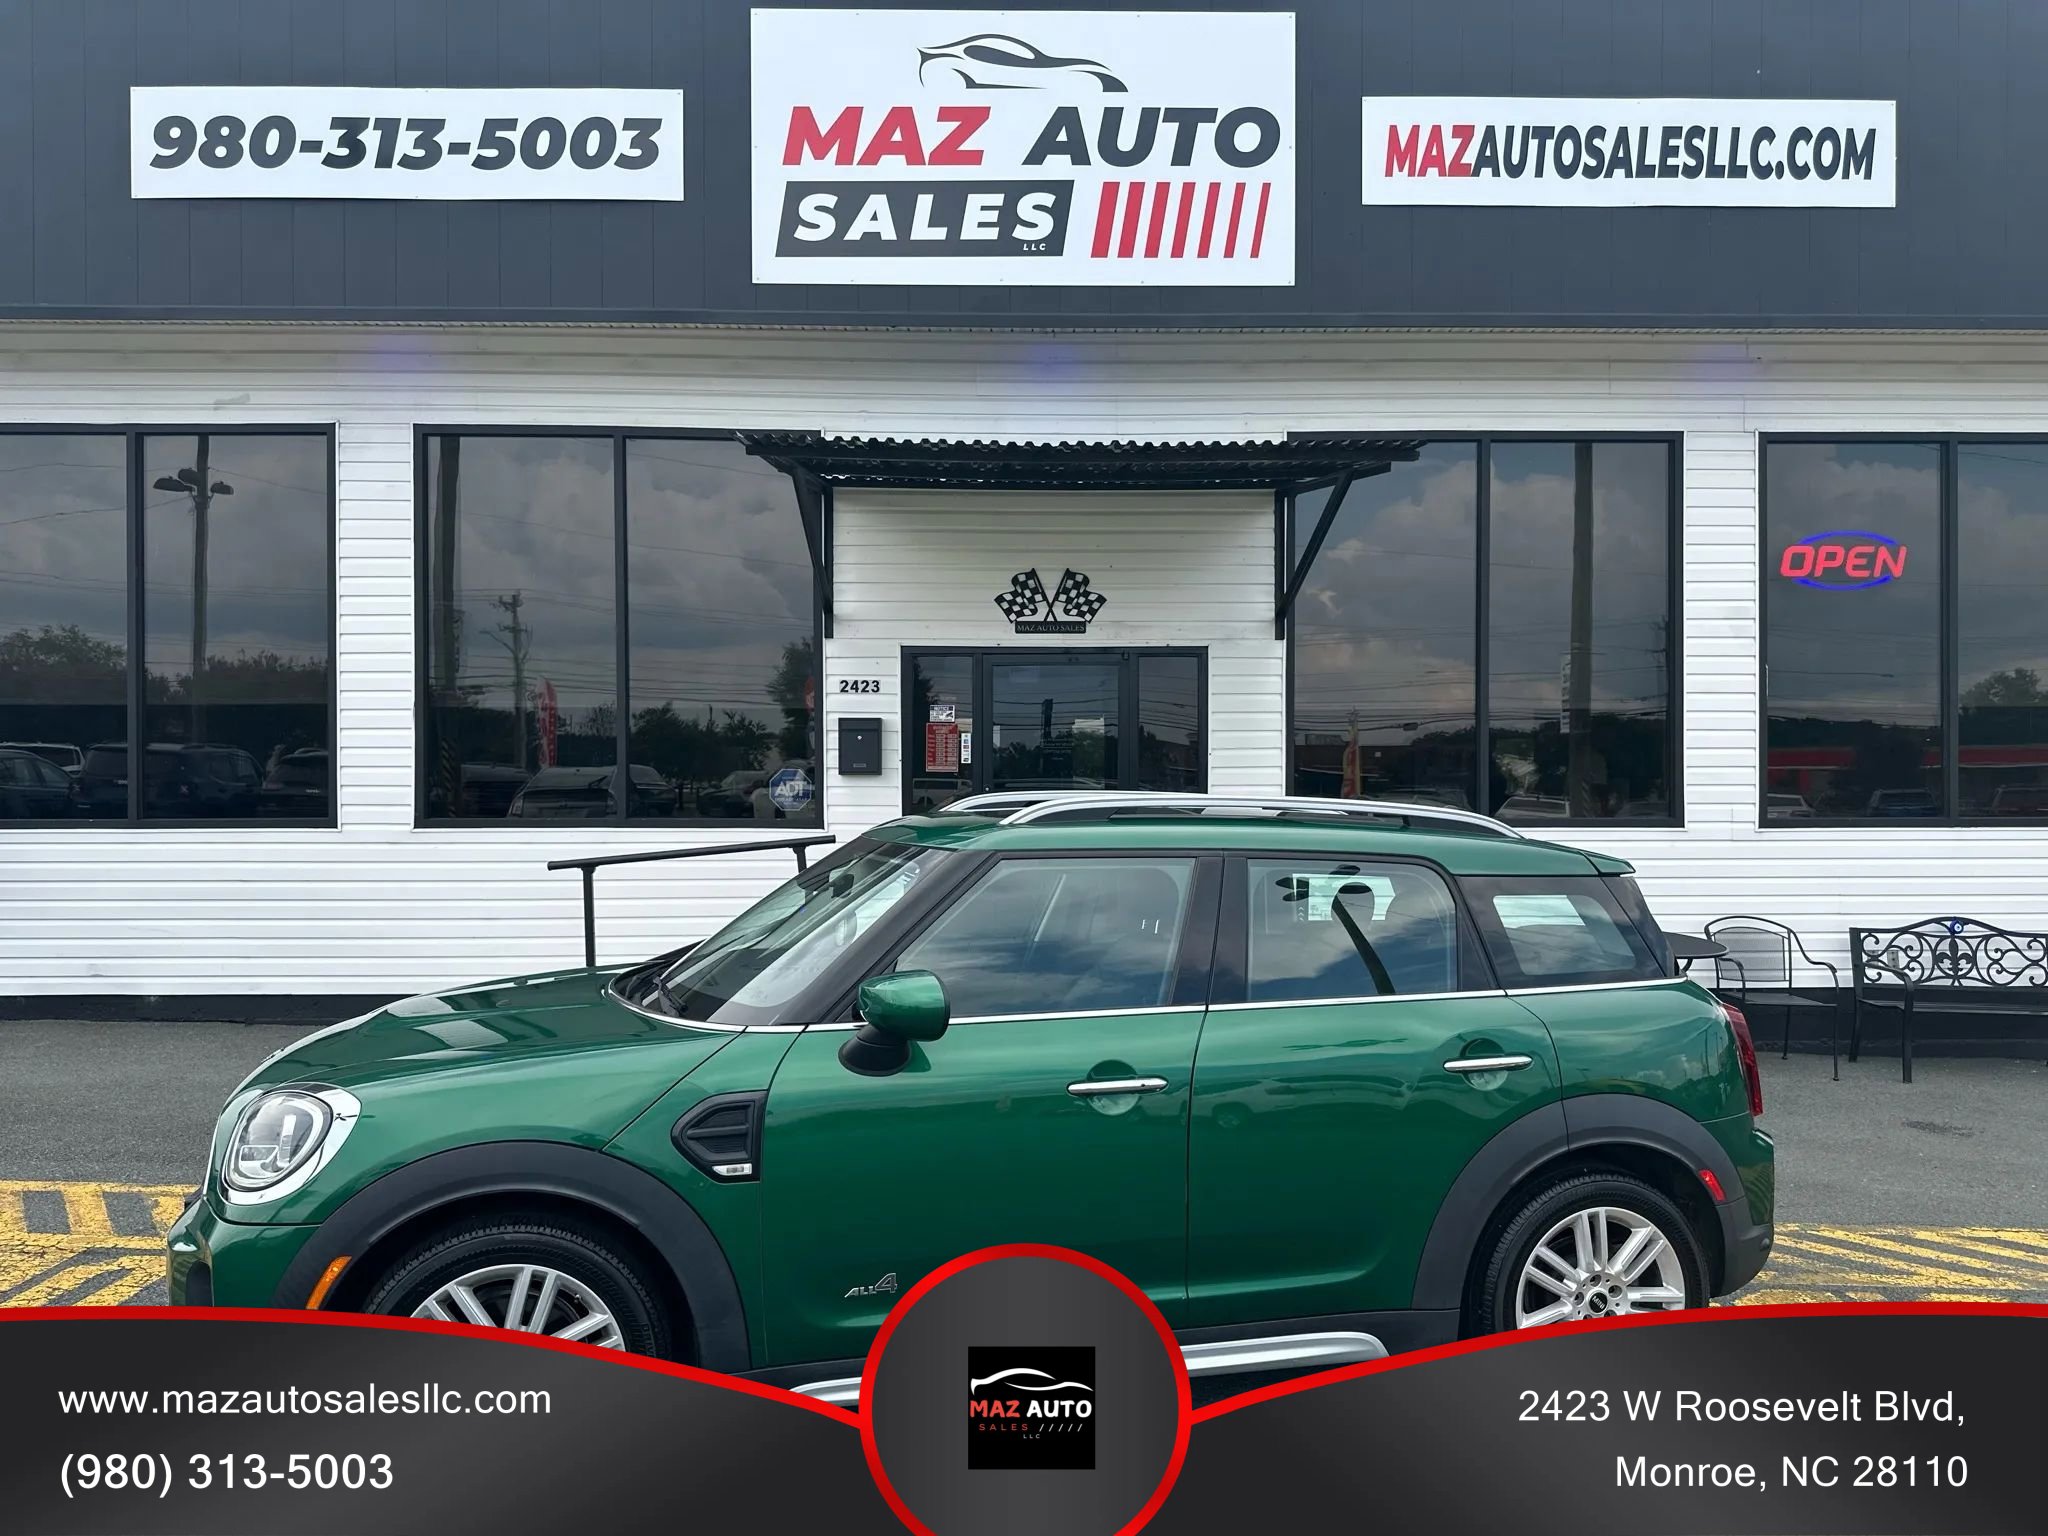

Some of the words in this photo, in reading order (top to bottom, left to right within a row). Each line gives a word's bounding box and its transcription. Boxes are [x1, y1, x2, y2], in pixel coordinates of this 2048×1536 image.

[149, 115, 663, 171] 980-313-5003
[782, 106, 991, 166] MAZ
[1021, 106, 1281, 168] AUTO
[1384, 124, 1877, 181] MAZAUTOSALESLLC.COM
[793, 193, 1056, 241] SALES
[1023, 243, 1046, 251] LLC
[1780, 545, 1907, 578] OPEN
[1017, 624, 1034, 632] MAZ
[1037, 624, 1059, 632] AUTO
[1060, 624, 1085, 632] SALES
[840, 680, 880, 693] 2423
[774, 780, 808, 797] ADT
